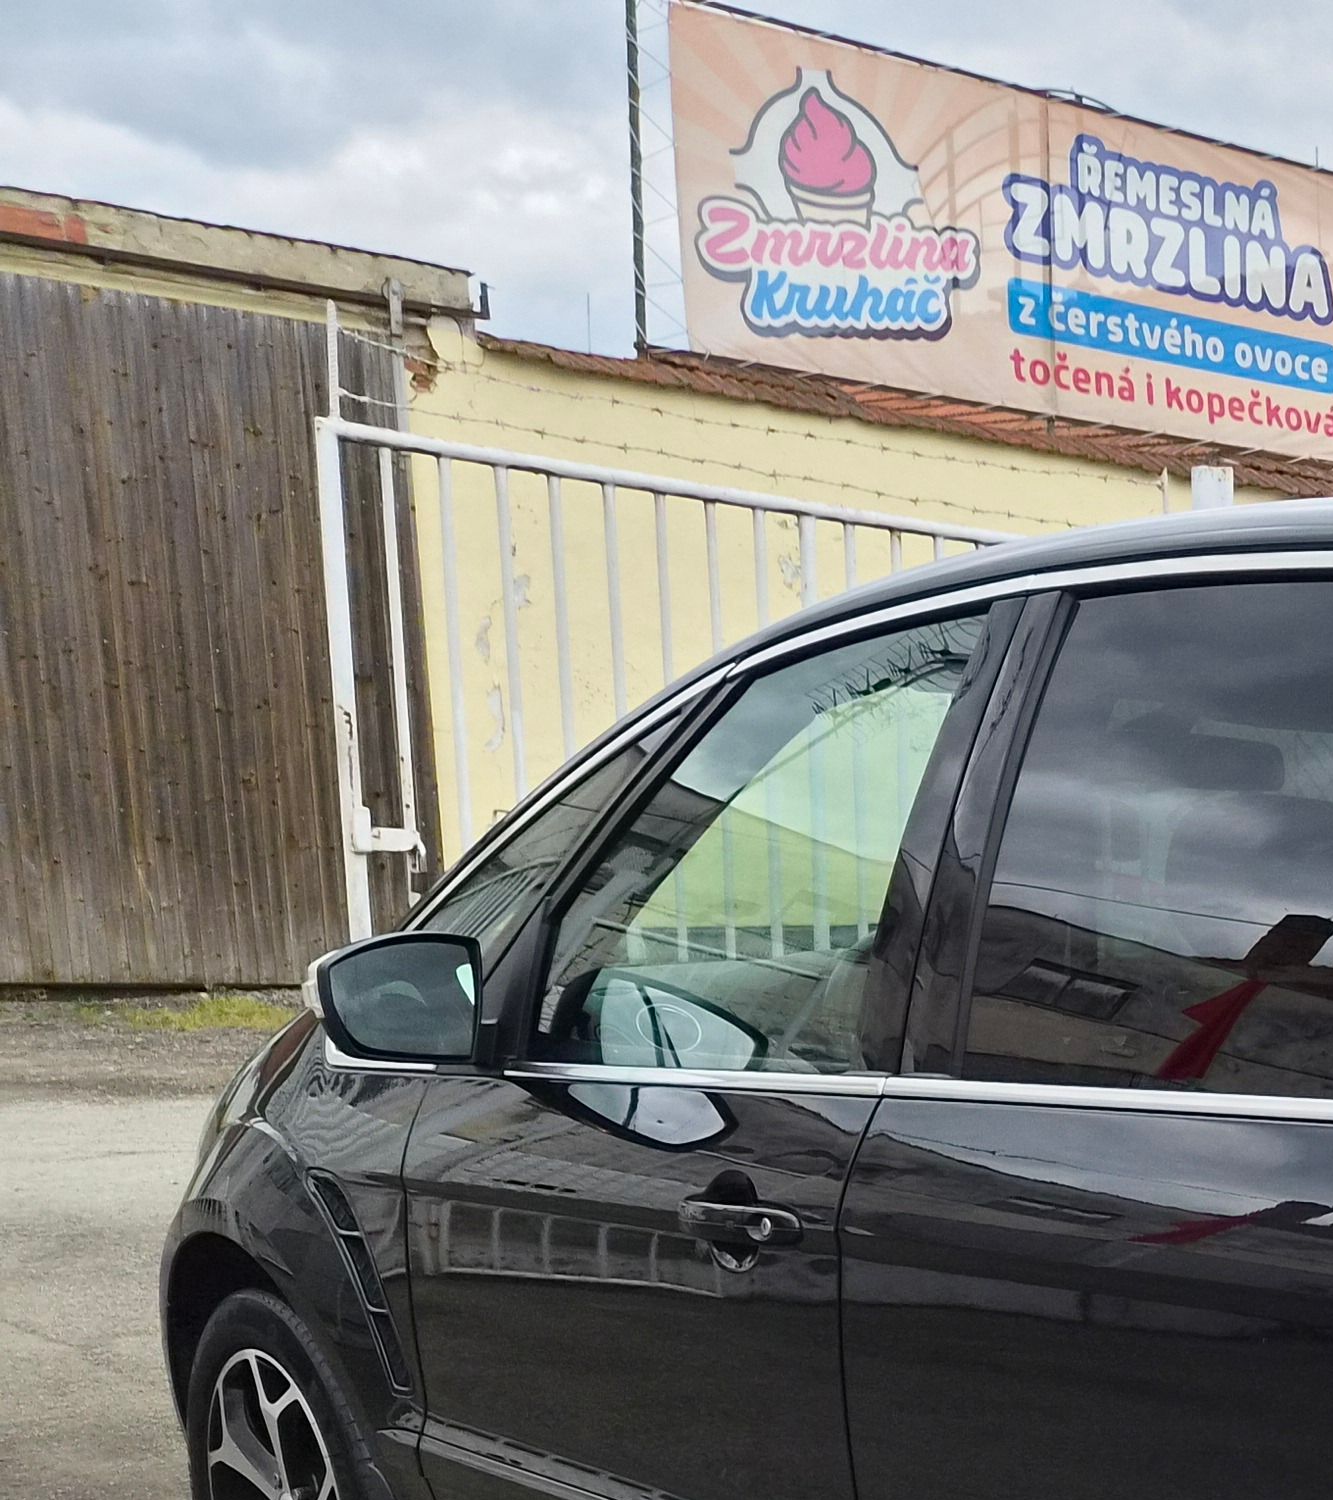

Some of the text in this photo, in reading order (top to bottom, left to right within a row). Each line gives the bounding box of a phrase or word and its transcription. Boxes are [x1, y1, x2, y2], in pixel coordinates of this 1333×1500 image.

[1077, 142, 1276, 240] ŘEMESLNÁ
[705, 207, 972, 273] Zmrzlina
[1010, 182, 1329, 318] ZMRZLINA
[751, 270, 943, 325] Kruháč
[1009, 348, 1135, 402] točená
[1145, 373, 1155, 405] i
[1018, 292, 1328, 384] z čerstvého ovoce
